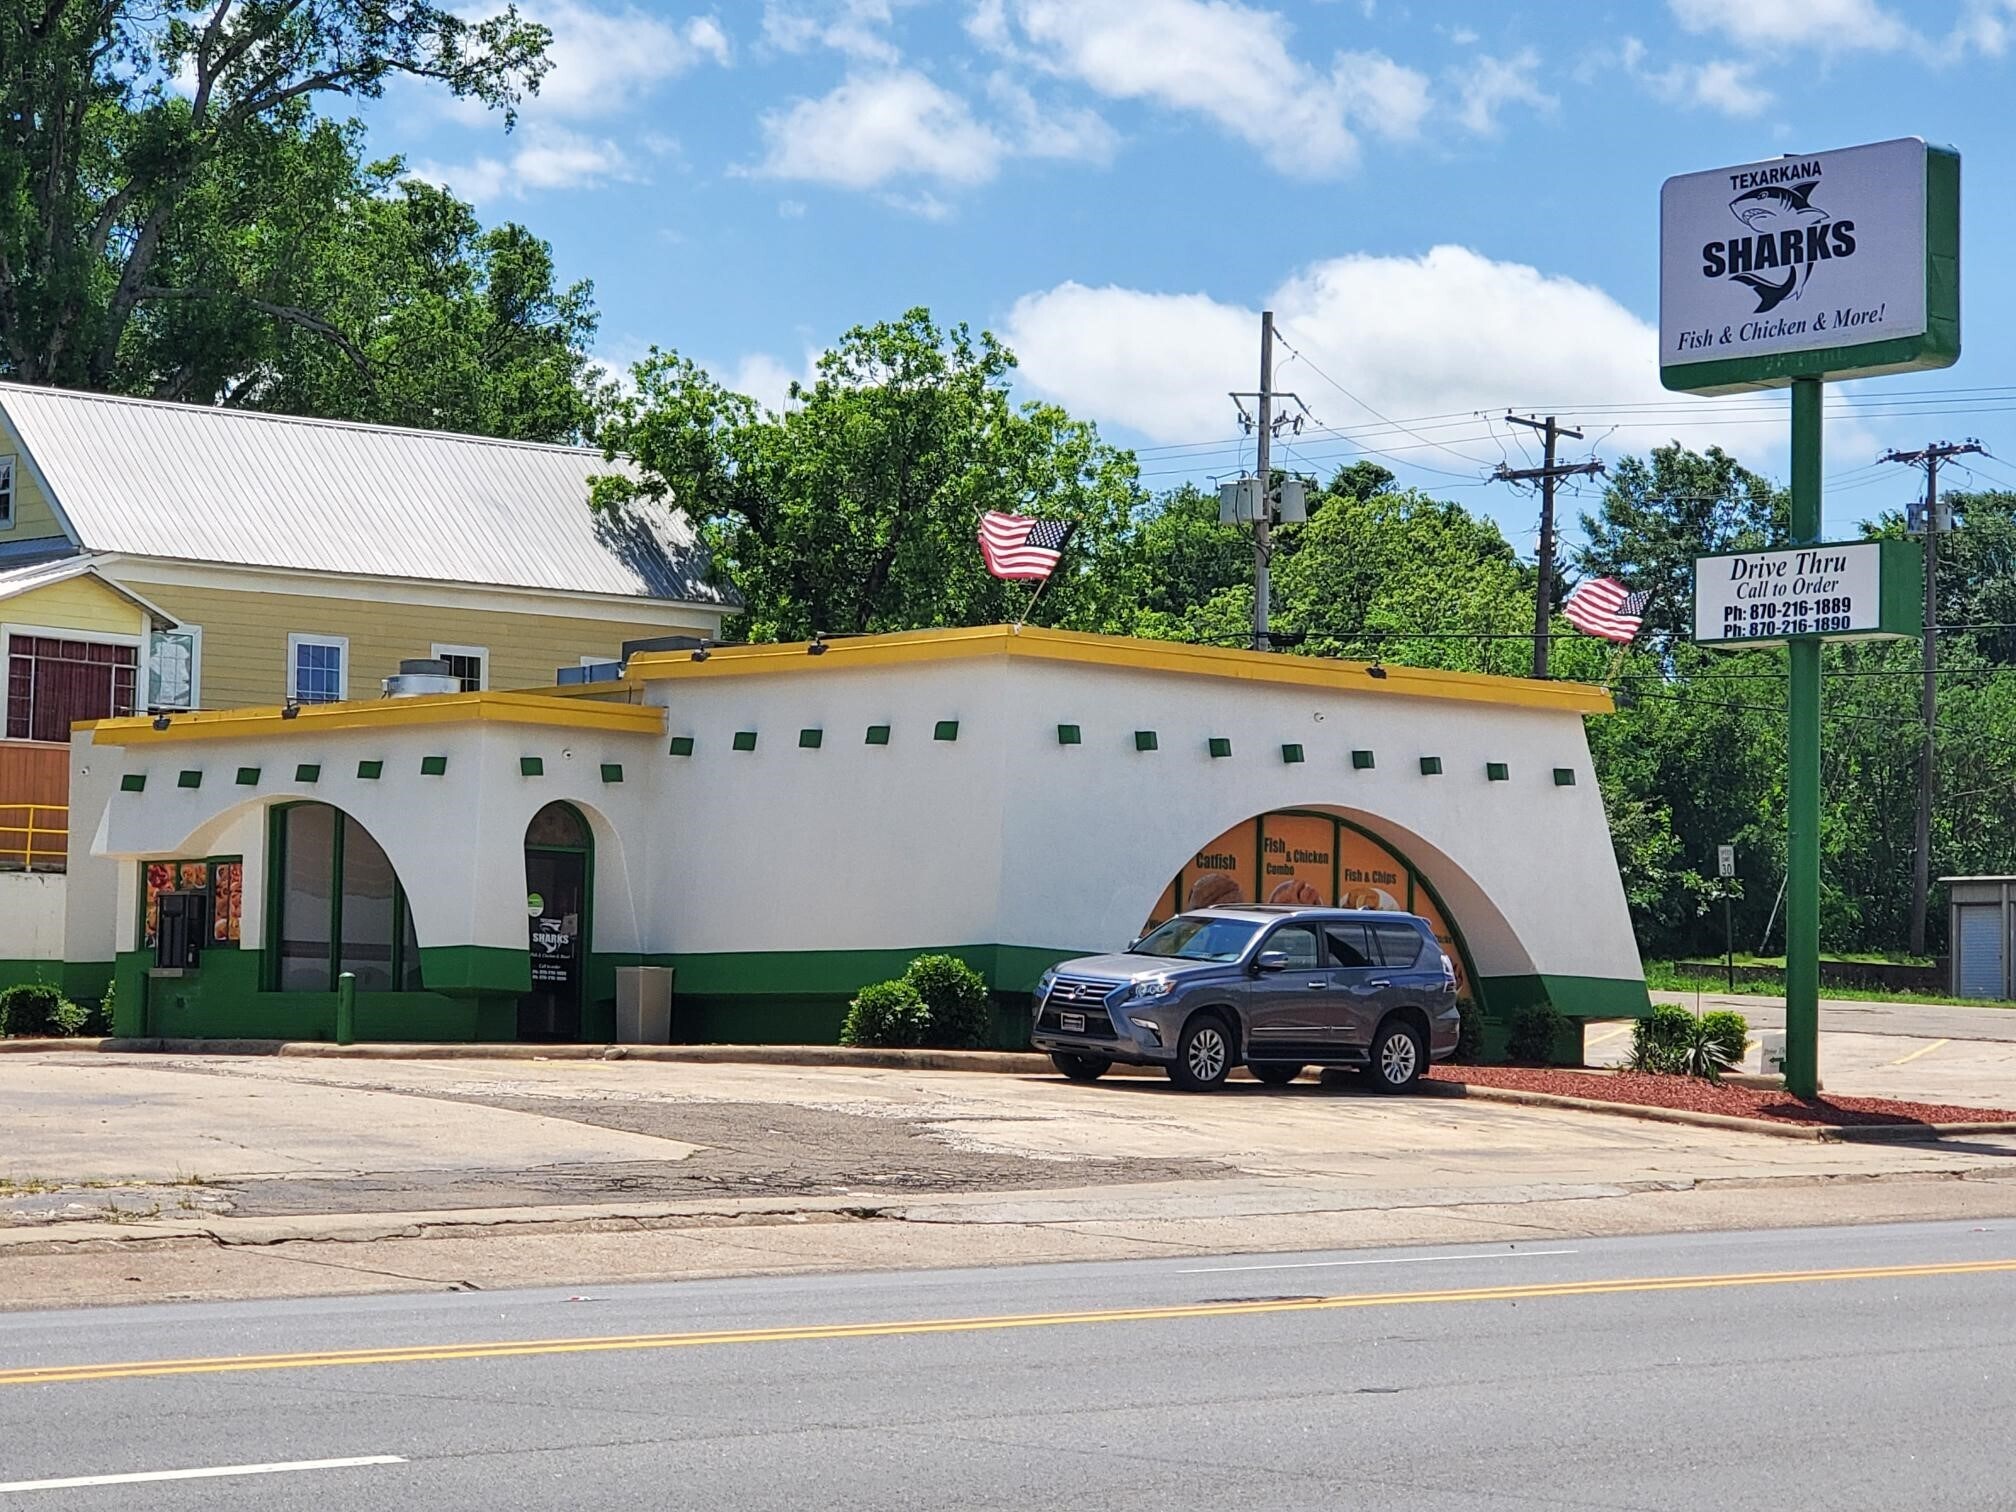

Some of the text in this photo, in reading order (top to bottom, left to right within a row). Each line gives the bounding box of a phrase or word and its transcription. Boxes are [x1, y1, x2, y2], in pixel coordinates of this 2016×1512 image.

[1730, 161, 1822, 190] TEXARKANA
[1703, 220, 1856, 277] SHARKS
[1677, 303, 1886, 350] Fish & Chicken & More!
[1730, 552, 1847, 581] Drive Thru
[1736, 577, 1839, 600] Call to Order
[1724, 597, 1851, 622] Ph: 870-216-1889
[1724, 616, 1850, 638] Ph: 870-216-1890
[1264, 837, 1285, 853] Fish
[1196, 852, 1236, 870] Catfish
[1286, 850, 1329, 865] & Chicken
[1266, 863, 1294, 876] Combo
[1345, 869, 1397, 884] Fish & Chips
[1722, 863, 1732, 875] 30
[532, 933, 569, 944] SHARKS
